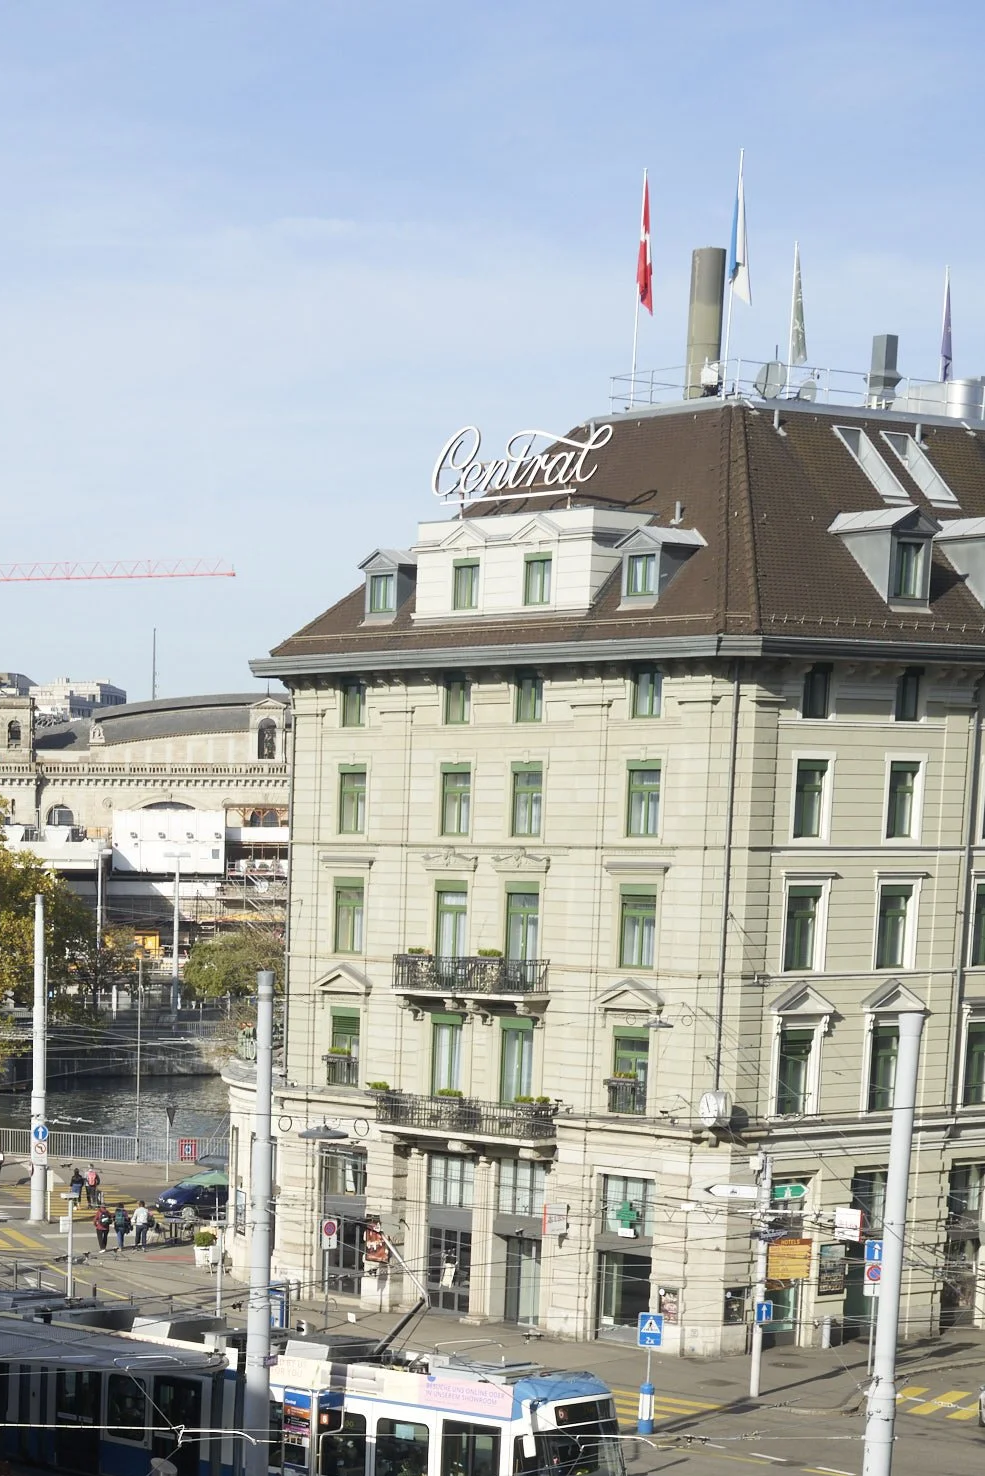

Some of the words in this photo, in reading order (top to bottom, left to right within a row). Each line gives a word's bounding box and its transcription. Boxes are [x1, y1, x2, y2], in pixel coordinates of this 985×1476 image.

[431, 424, 614, 498] Central
[645, 1336, 655, 1345] 2x
[434, 1390, 461, 1400] UNSEREM
[462, 1394, 498, 1405] SHOWROOM
[452, 1385, 465, 1394] UNS
[465, 1387, 489, 1398] ONLINE
[489, 1390, 506, 1400] ODER
[558, 1408, 565, 1420] 6
